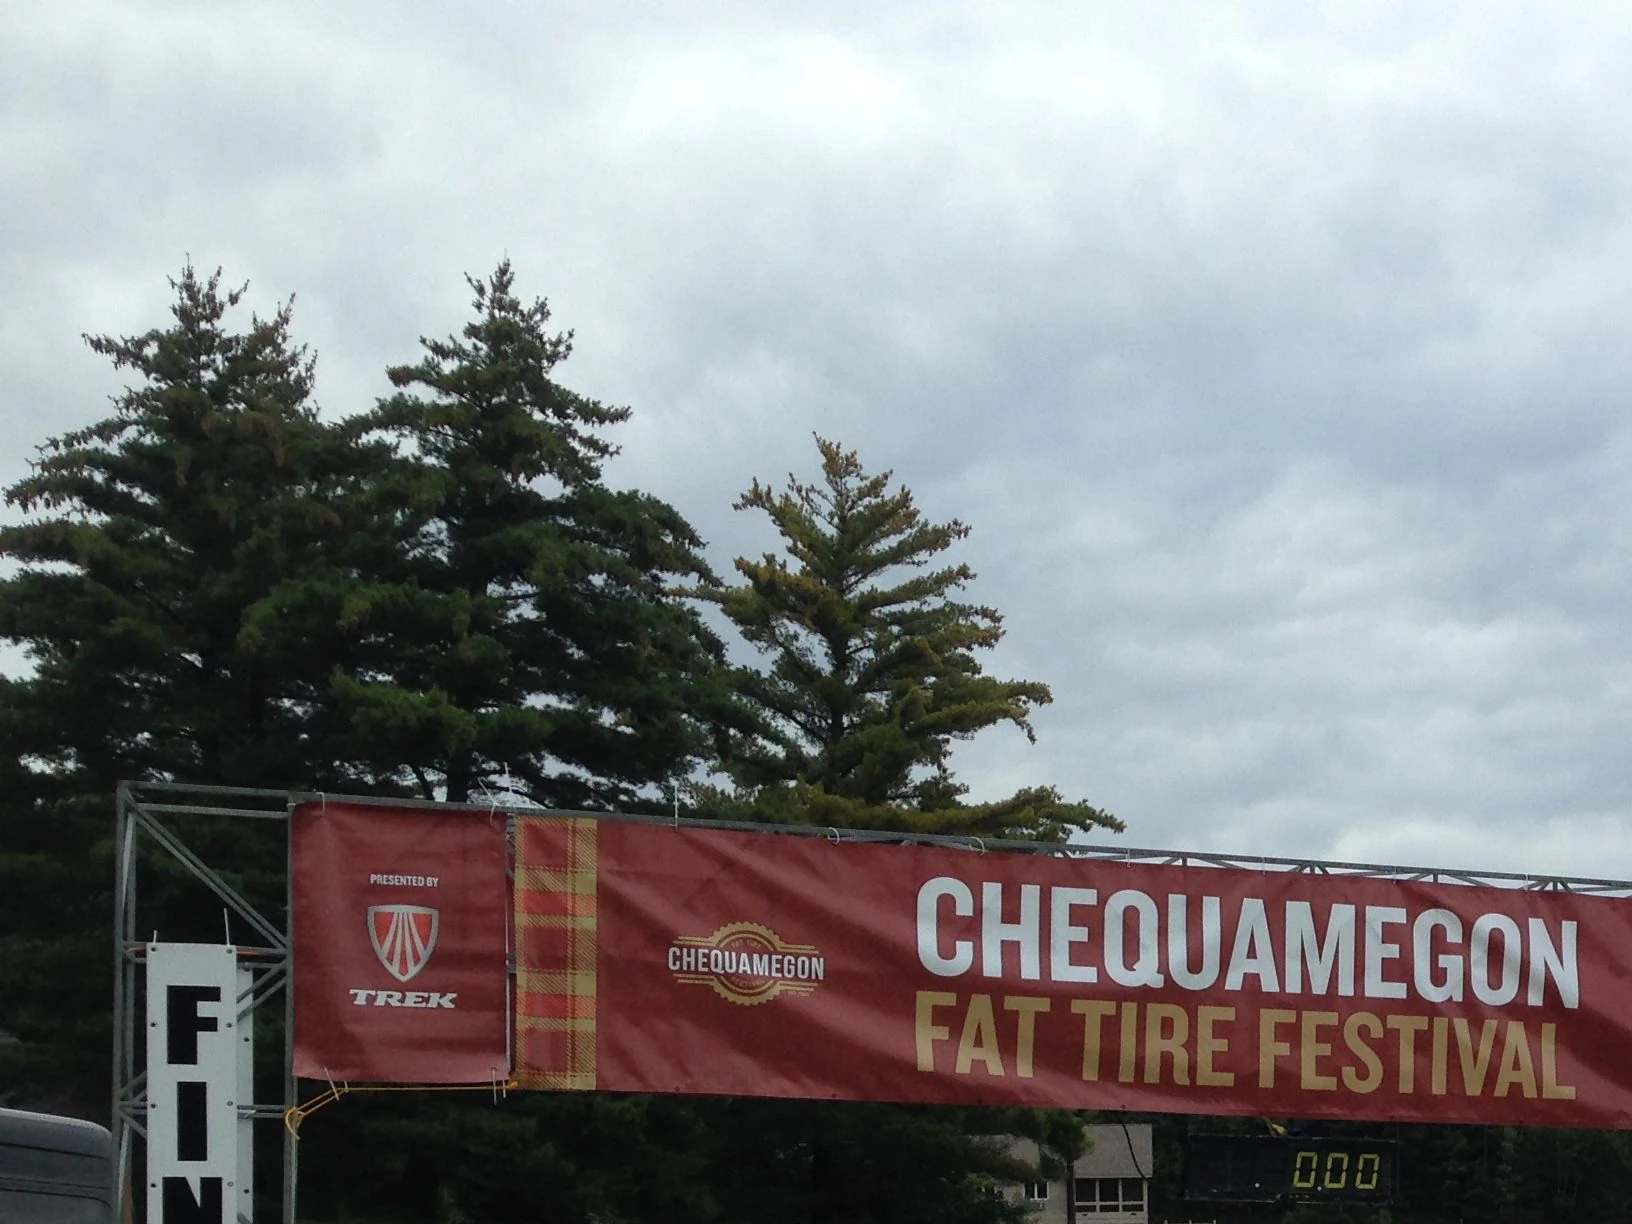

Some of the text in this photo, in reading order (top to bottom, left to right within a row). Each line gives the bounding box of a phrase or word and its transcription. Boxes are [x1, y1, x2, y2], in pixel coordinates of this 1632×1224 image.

[370, 873, 439, 888] PRESENTED BY
[915, 876, 1580, 1010] CHEQUAMEGON
[667, 946, 825, 981] CHEQUAMEGON
[349, 988, 458, 1009] TREK
[915, 989, 1577, 1100] FAT TIRE FESTIVAL
